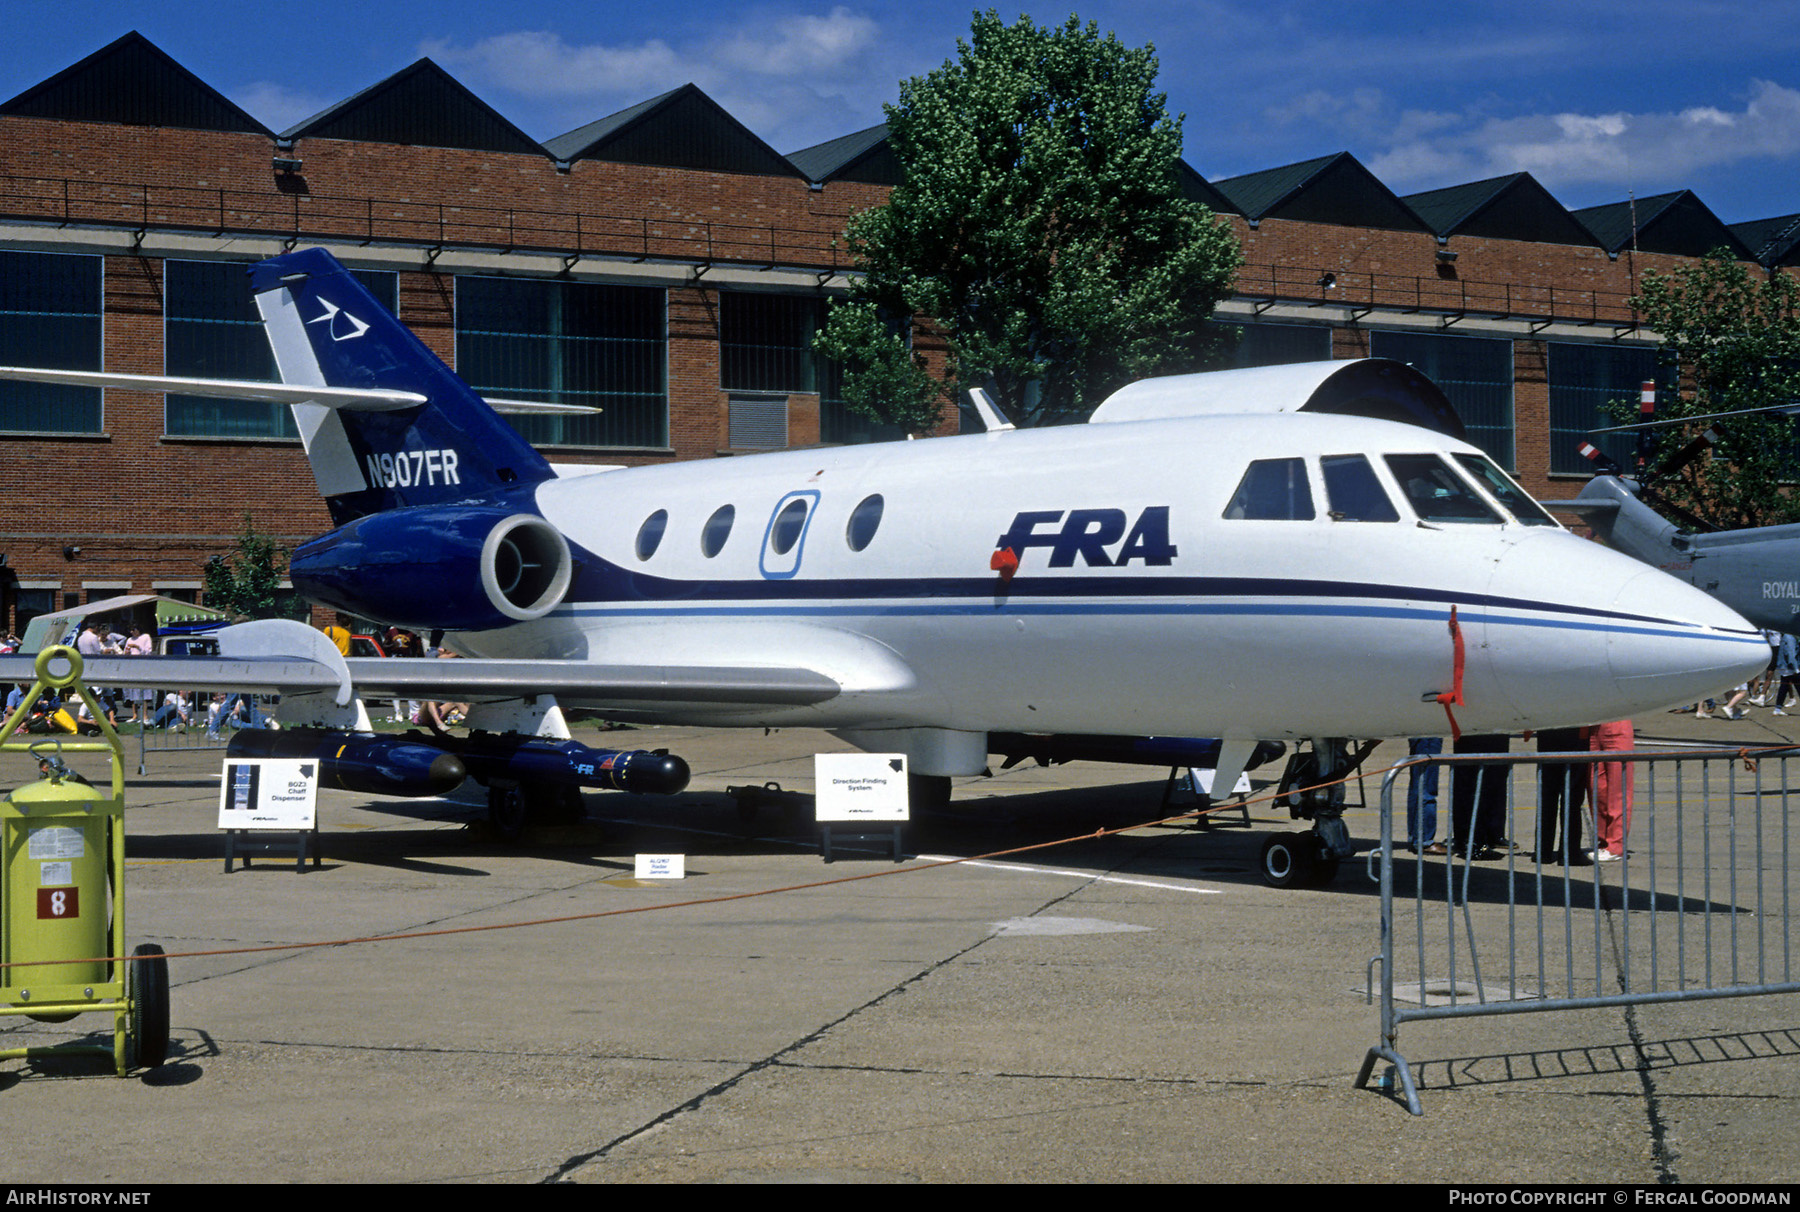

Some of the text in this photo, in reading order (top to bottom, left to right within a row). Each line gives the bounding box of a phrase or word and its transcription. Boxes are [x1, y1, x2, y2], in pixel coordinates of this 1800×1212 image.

[366, 449, 461, 488] N907FR
[996, 506, 1178, 568] FRA
[1762, 581, 1800, 599] ROYAL
[847, 784, 872, 792] System
[862, 777, 888, 786] Finding
[271, 795, 306, 803] Dispenser
[50, 890, 66, 916] 8
